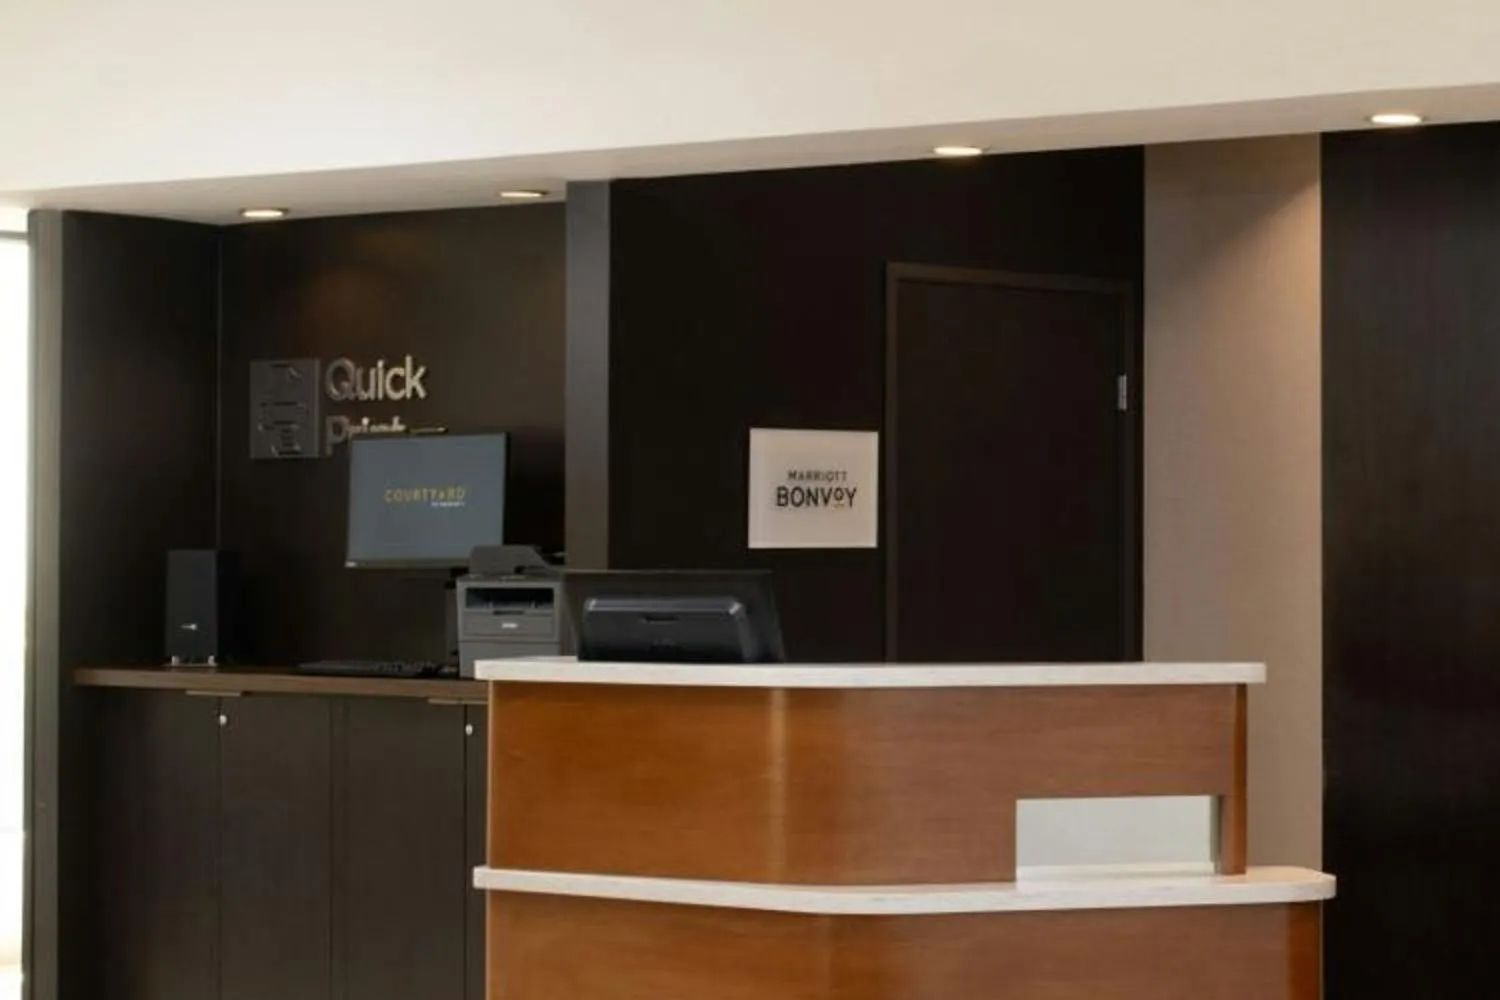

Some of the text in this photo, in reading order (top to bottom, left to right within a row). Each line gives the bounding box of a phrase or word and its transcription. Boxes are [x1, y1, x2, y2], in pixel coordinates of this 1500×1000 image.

[325, 355, 427, 401] Quick
[326, 415, 406, 456] Pit
[787, 470, 848, 481] MARRIOTT
[384, 486, 466, 503] COURTYARD
